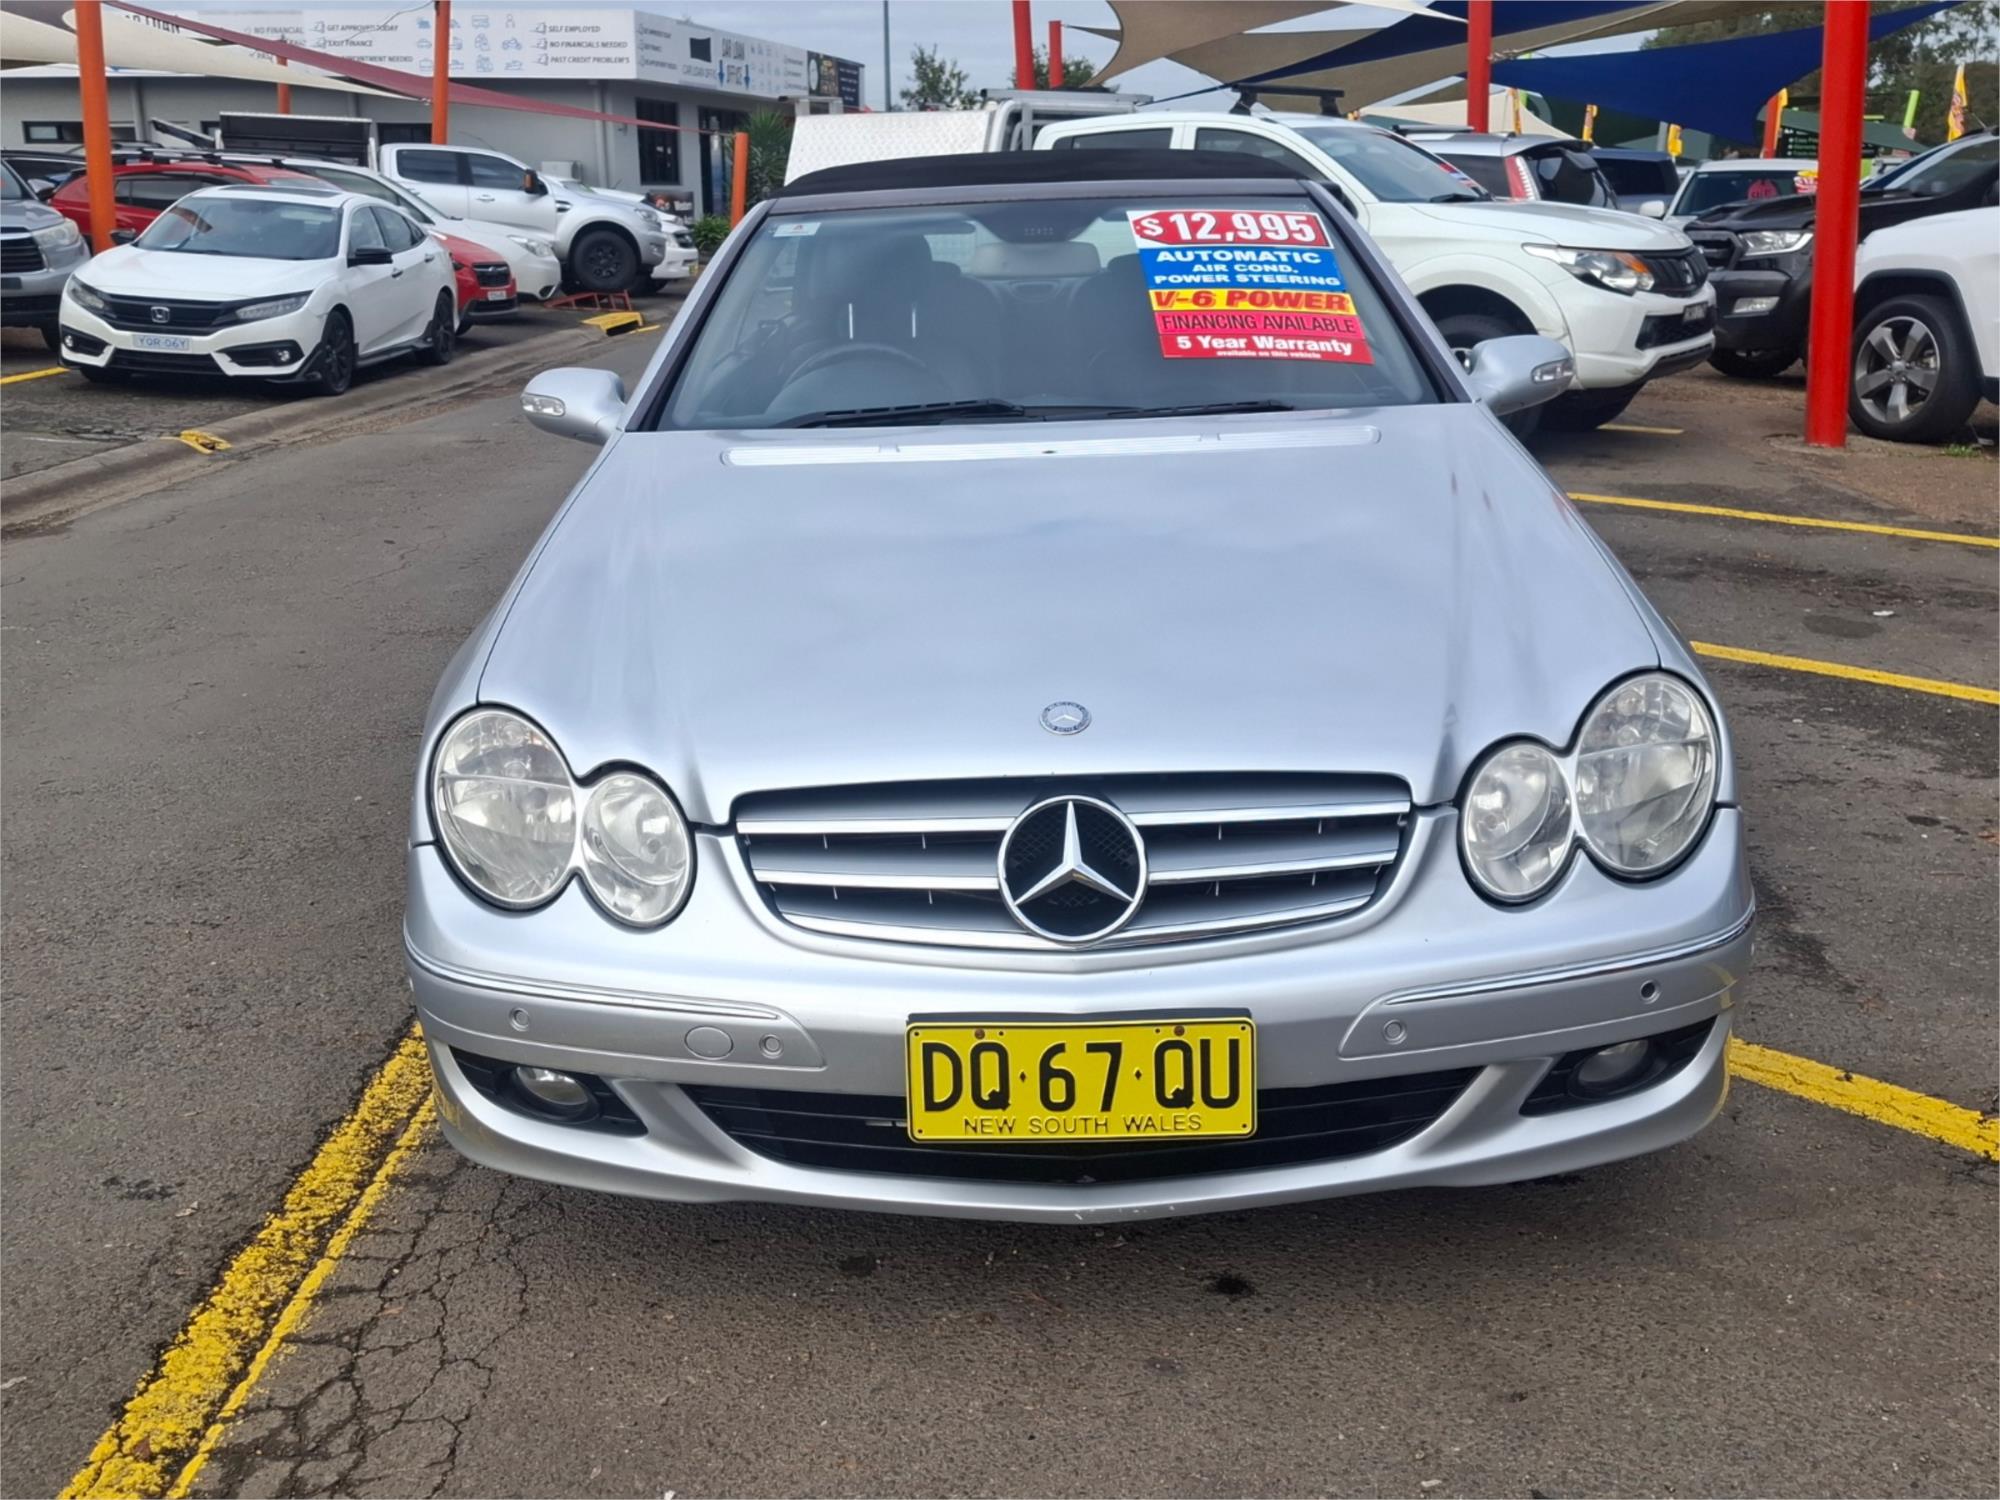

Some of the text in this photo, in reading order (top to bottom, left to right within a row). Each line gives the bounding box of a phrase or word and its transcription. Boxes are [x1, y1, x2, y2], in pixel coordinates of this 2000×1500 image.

[548, 25, 601, 33] SELF EMPLOYED
[561, 41, 600, 49] FINANCIALS
[601, 41, 628, 49] NEEDED
[550, 56, 567, 64] PAST
[1156, 250, 1322, 264] AUTOMATIC
[1192, 263, 1299, 274] AIR COND.
[1154, 273, 1341, 286] POWER STEERING
[1154, 290, 1350, 312] V-6 POWER
[1161, 314, 1357, 334] FINANCING AVAILABLE
[1176, 335, 1352, 356] 5 Year Warranty
[963, 1113, 1203, 1135] NEW SOUTH WALES
